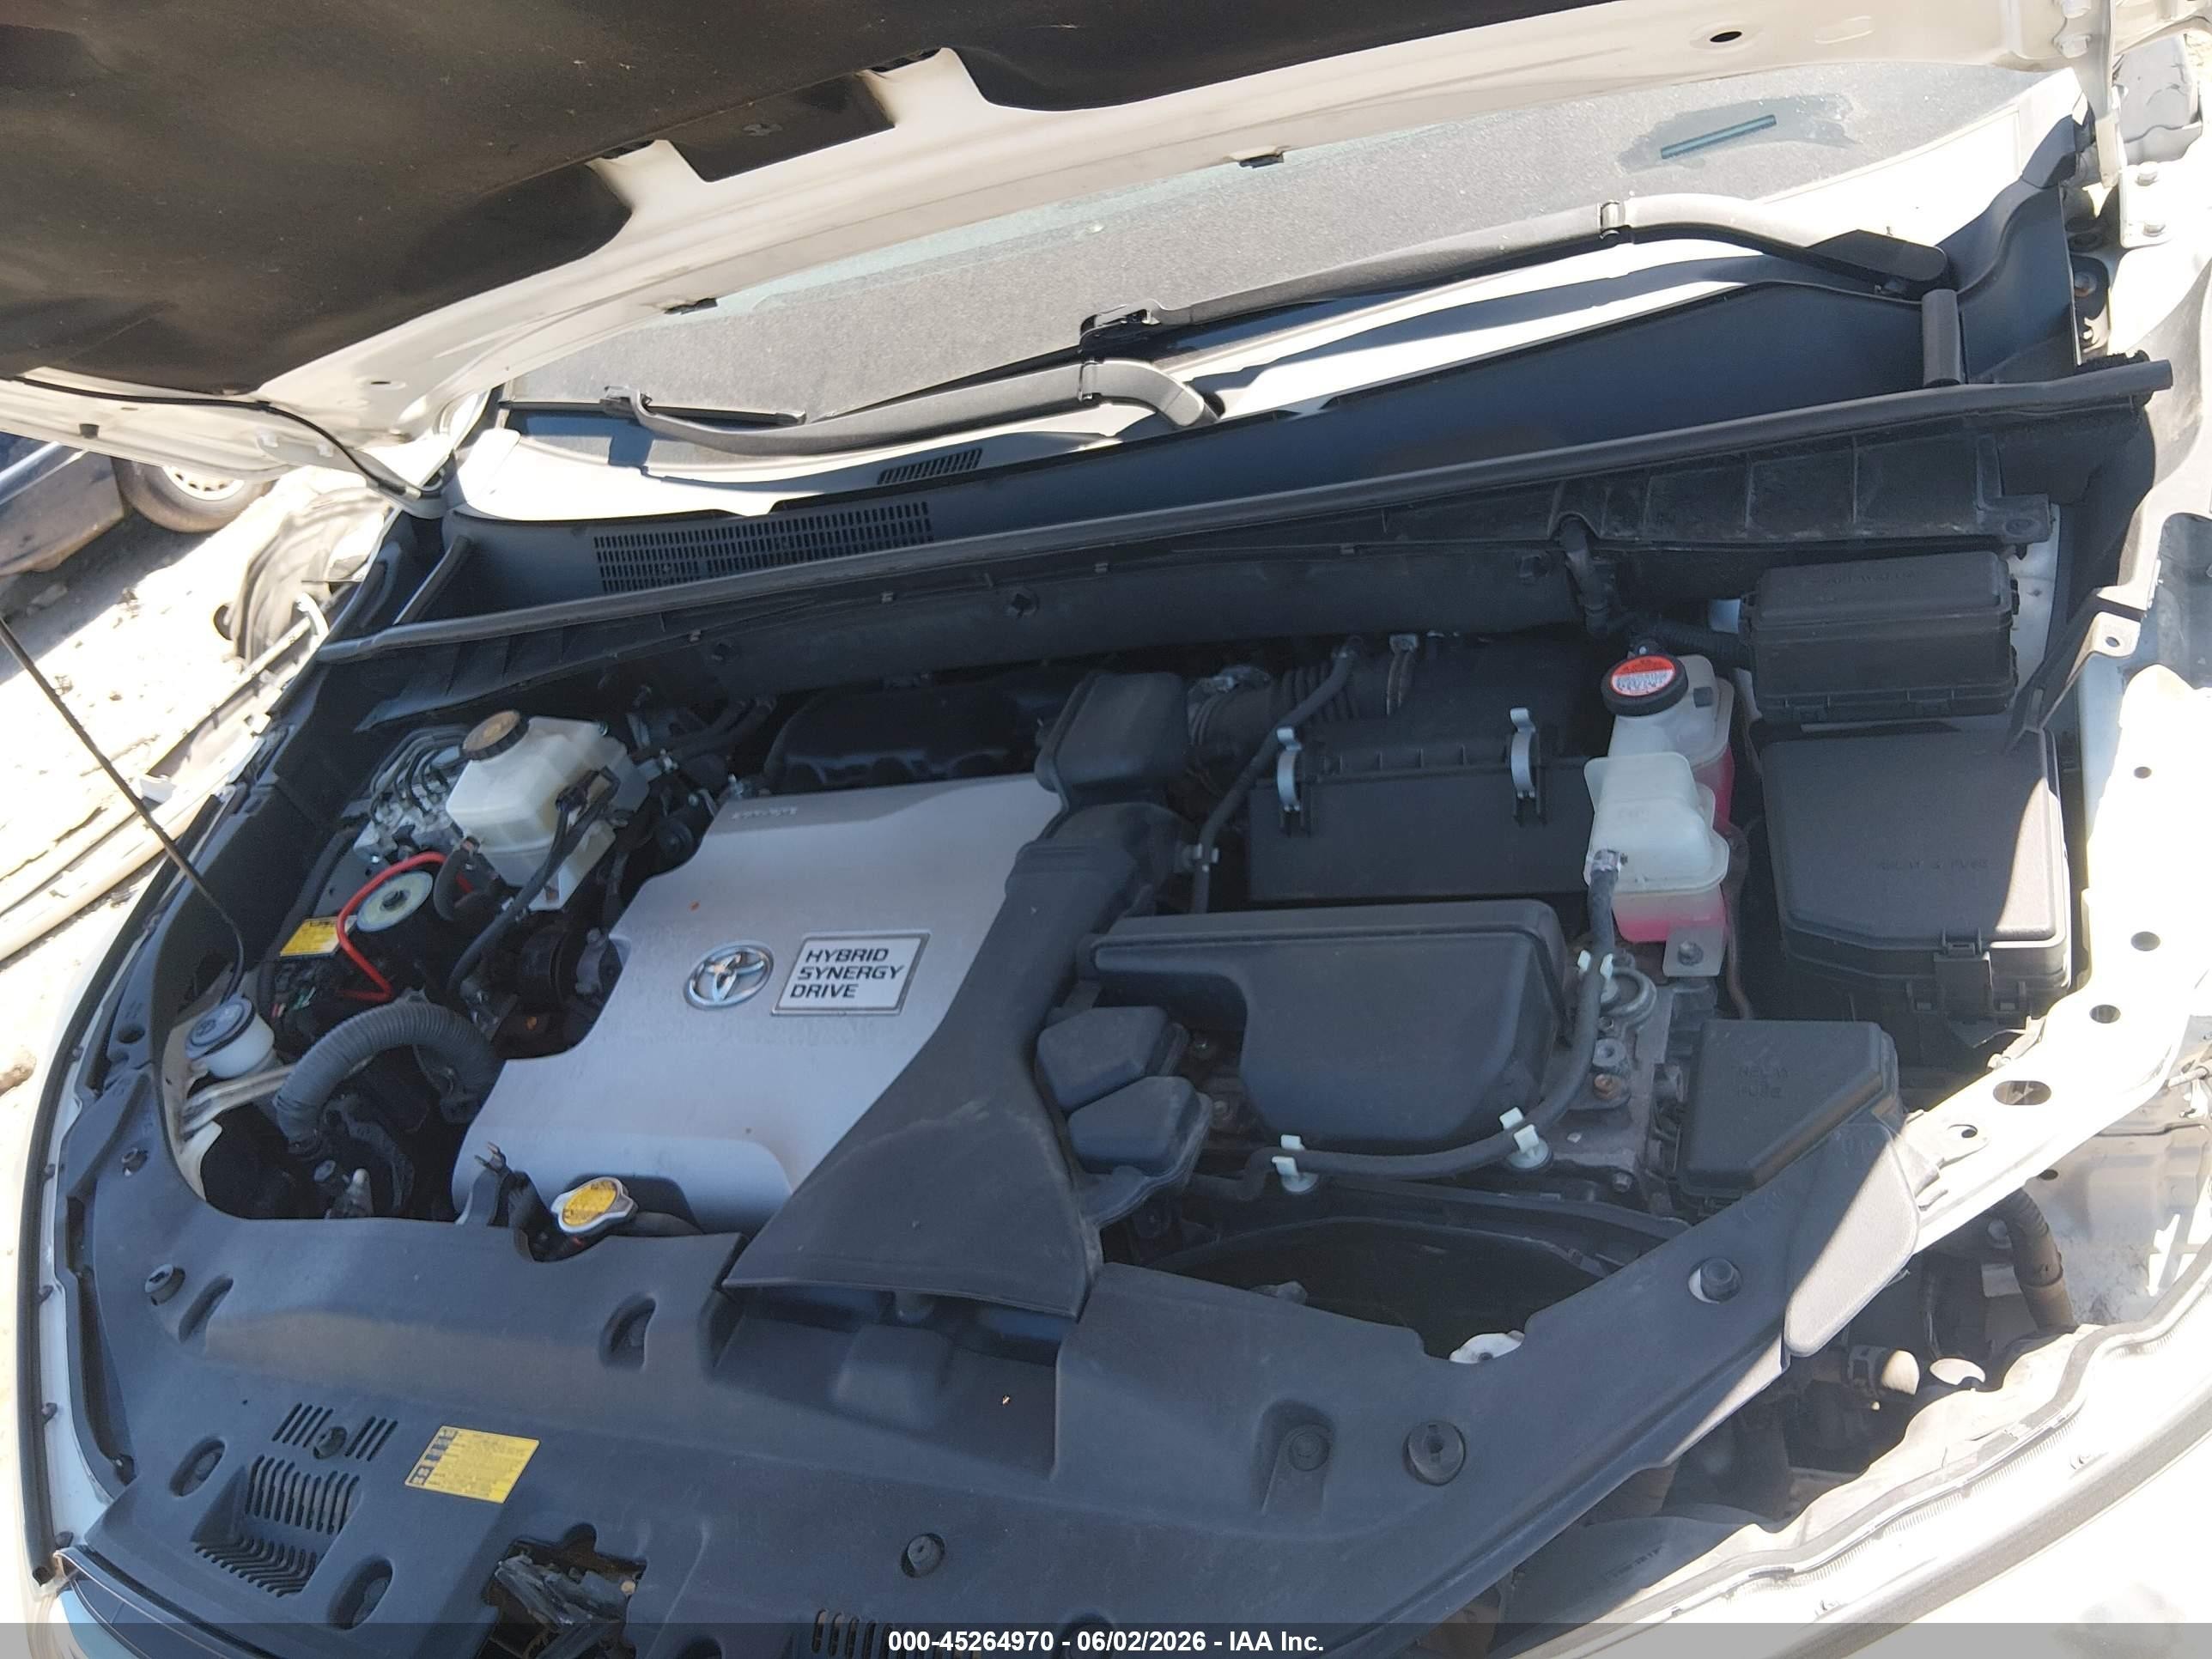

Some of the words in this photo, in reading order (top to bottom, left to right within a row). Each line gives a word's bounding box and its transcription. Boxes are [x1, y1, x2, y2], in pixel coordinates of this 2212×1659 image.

[805, 947, 890, 963] HYBRID
[797, 964, 905, 981] SYNERGY
[789, 983, 860, 999] DRIVE
